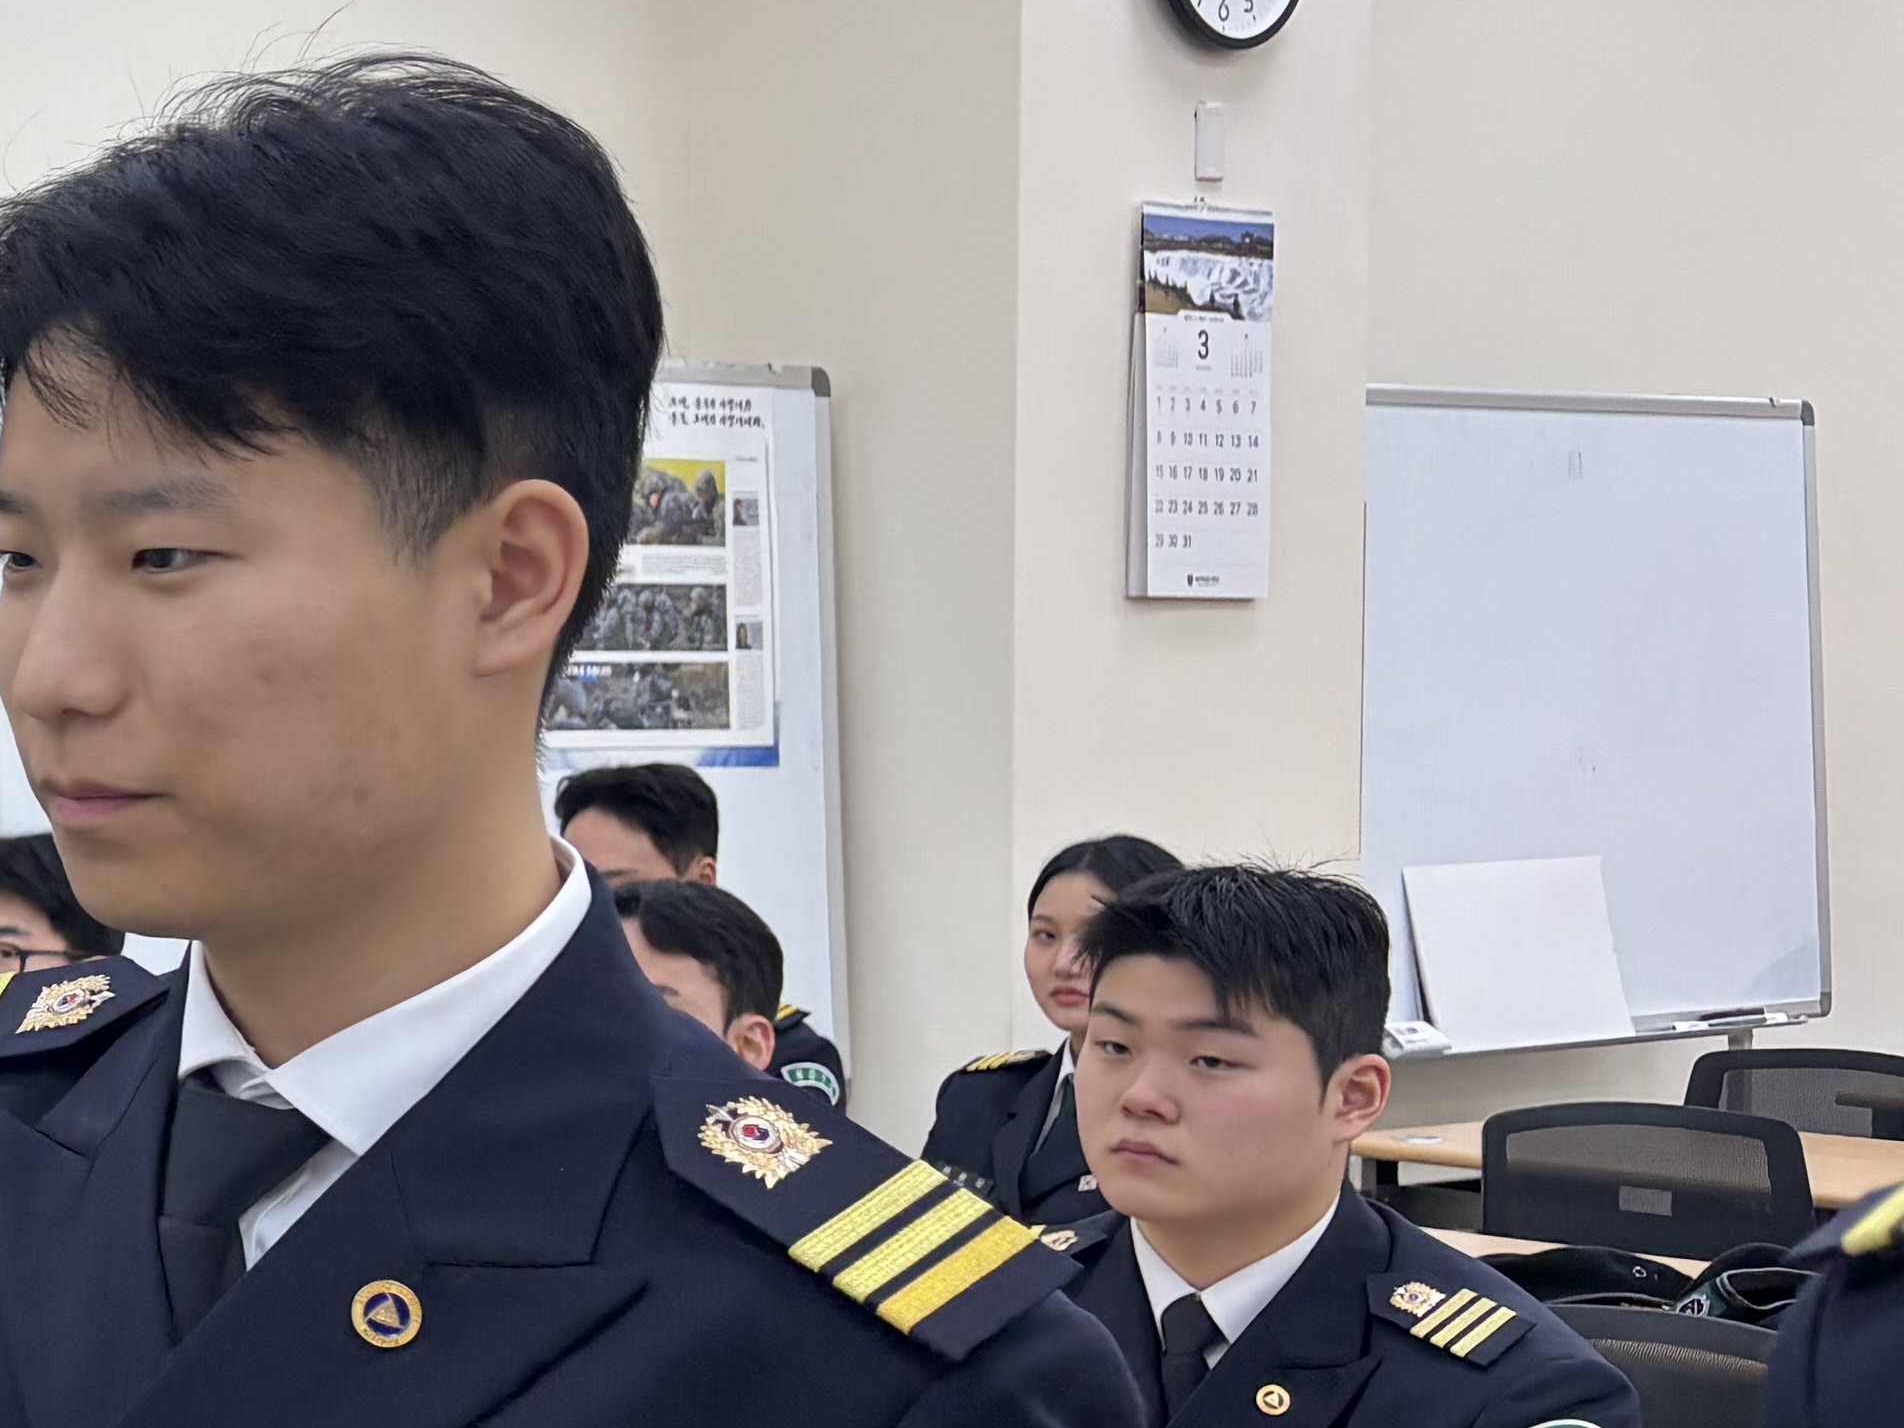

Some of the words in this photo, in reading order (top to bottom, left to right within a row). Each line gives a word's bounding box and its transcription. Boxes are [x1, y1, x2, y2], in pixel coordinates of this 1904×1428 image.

[1198, 329, 1209, 359] 3
[1200, 399, 1206, 412] 4
[1216, 399, 1223, 414] 5
[1232, 400, 1239, 414] 6
[1184, 433, 1193, 446] 10
[1199, 433, 1208, 447] 11
[1215, 433, 1225, 448] 12
[1231, 434, 1241, 448] 13
[1248, 435, 1259, 449] 14
[1169, 464, 1178, 480] 16
[1184, 466, 1192, 480] 17
[1199, 466, 1208, 481] 18
[1215, 467, 1225, 482] 19
[1230, 467, 1241, 482] 20
[1247, 468, 1257, 483] 21
[1168, 498, 1178, 514] 23
[1182, 499, 1192, 515] 24
[1198, 500, 1208, 515] 25
[1214, 500, 1224, 516] 26
[1230, 501, 1241, 516] 27
[1247, 502, 1258, 517] 28
[1168, 533, 1178, 548] 30
[1182, 534, 1192, 548] 31
